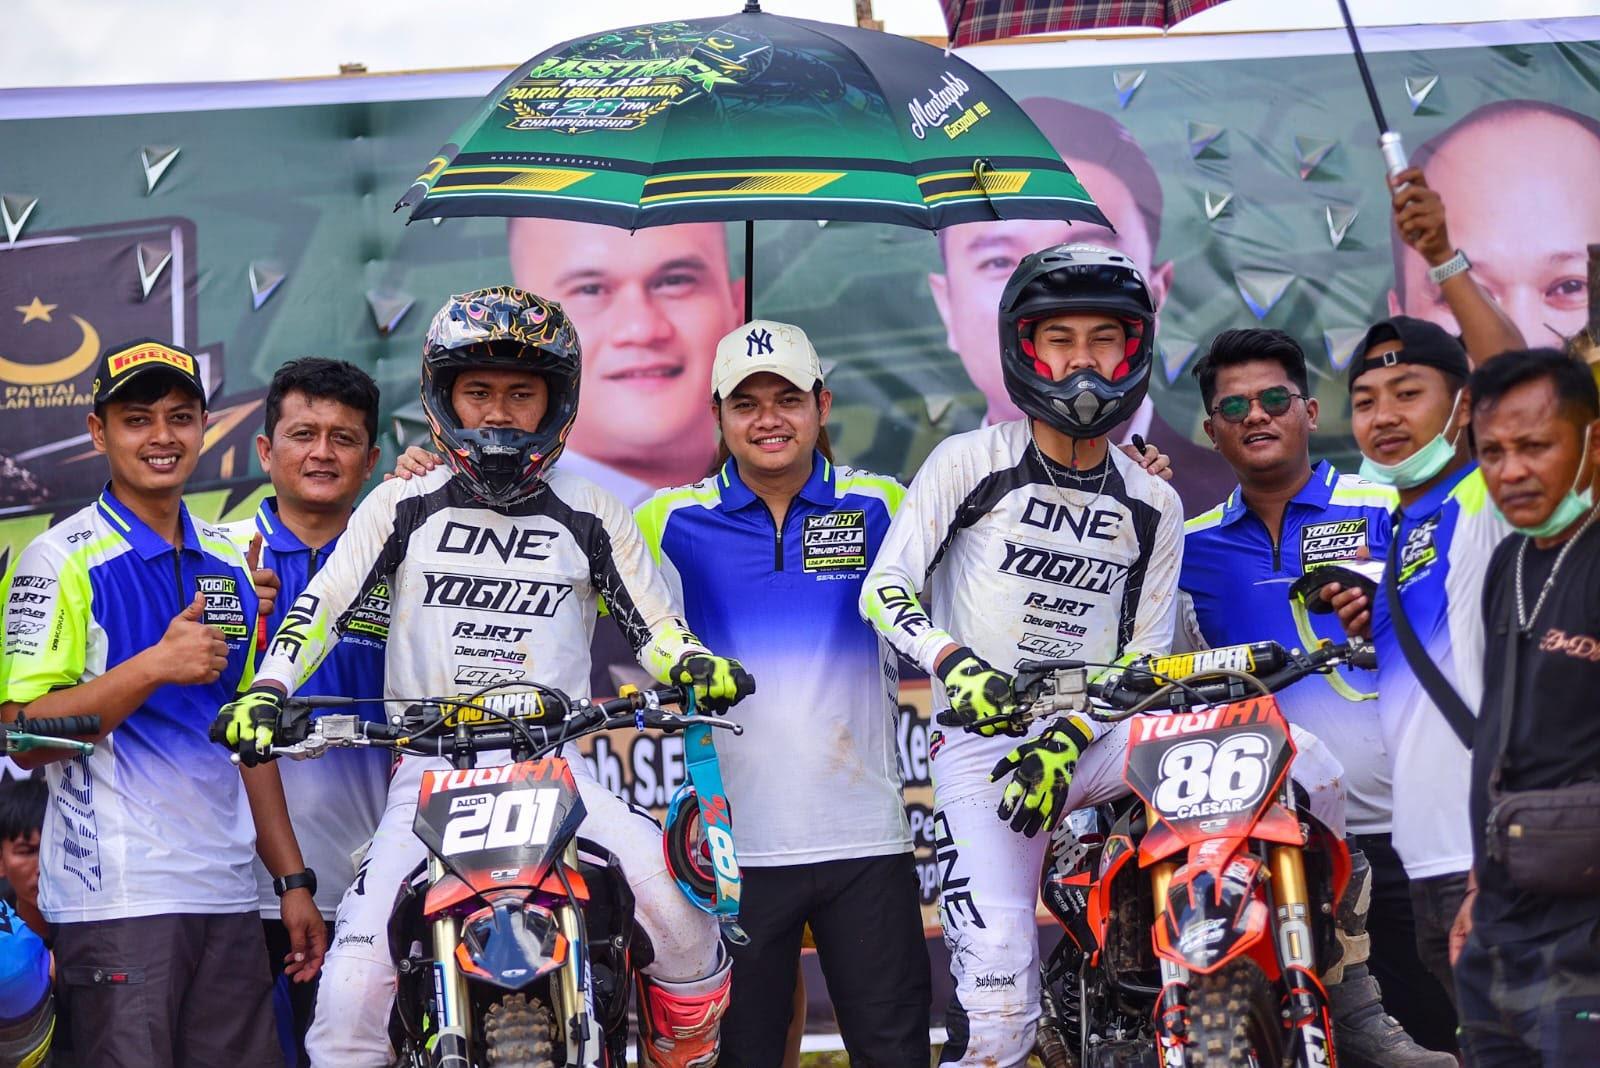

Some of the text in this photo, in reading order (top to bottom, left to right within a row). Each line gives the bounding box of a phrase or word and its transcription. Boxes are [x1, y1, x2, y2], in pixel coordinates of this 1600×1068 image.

[560, 77, 652, 87] MILAD
[508, 87, 565, 100] PARTAI
[565, 86, 625, 98] BULAN
[537, 102, 556, 110] KE
[621, 101, 650, 110] THN
[519, 118, 634, 128] CHAMPIONSHIP
[746, 328, 774, 357] NY
[5, 384, 75, 398] PARTAI
[1020, 496, 1124, 543] ONE
[1305, 519, 1365, 539] YOGIHY
[437, 521, 560, 565] ONE
[806, 530, 863, 544] RJRT
[1305, 534, 1363, 551] RJRT
[808, 546, 862, 556] DevanPutra
[1307, 548, 1358, 562] DevanPutr
[998, 540, 1129, 595] YOGIHY
[199, 578, 236, 594] YOGIHY
[422, 571, 573, 618] YOGIHY
[9, 592, 51, 604] RJRT
[1024, 592, 1096, 617] RJRT
[877, 585, 935, 637] ONE
[271, 593, 321, 665] ONE
[452, 621, 533, 642] RJRT
[1023, 613, 1088, 636] DevanPutra
[454, 645, 528, 662] DevanPutra
[1153, 733, 1271, 813] 86
[1177, 799, 1244, 819] CAESAR
[442, 788, 560, 857] 201
[934, 810, 988, 931] ONE
